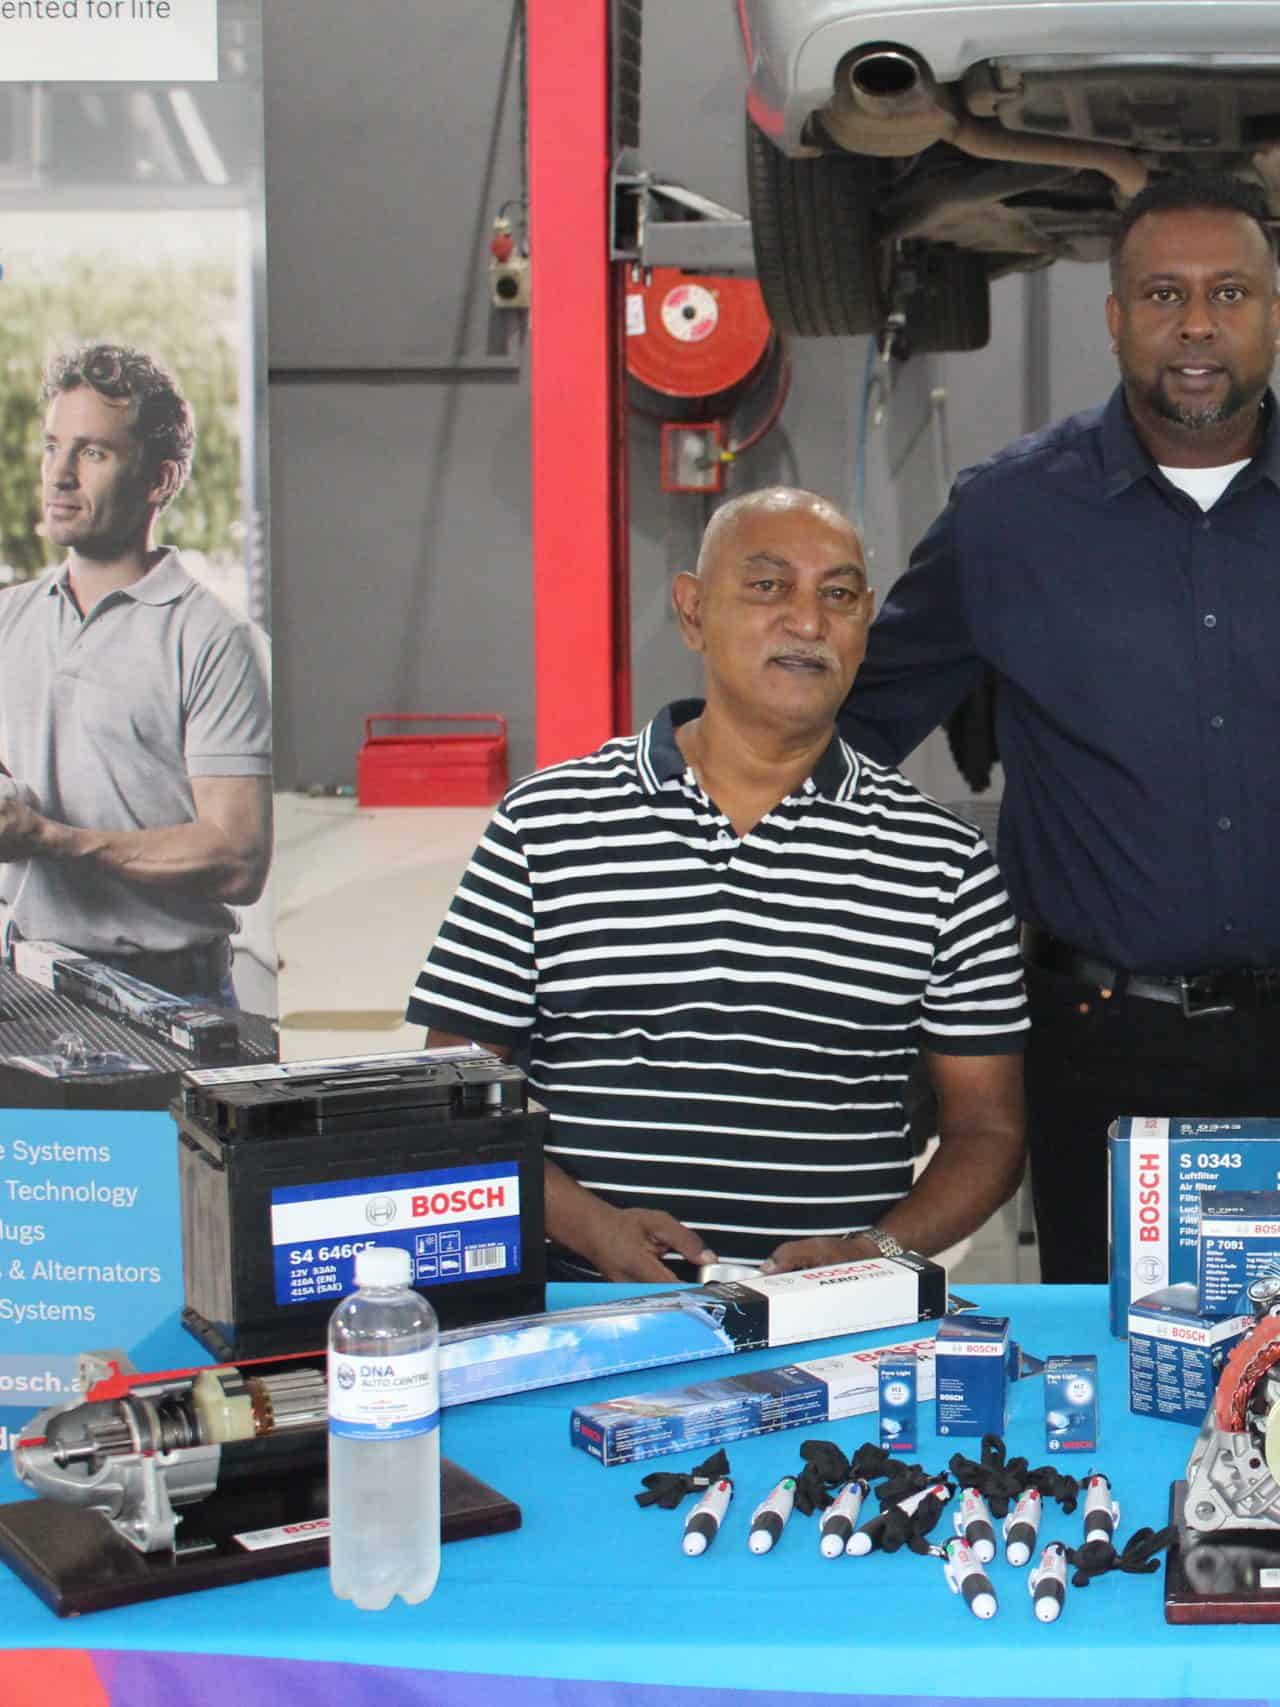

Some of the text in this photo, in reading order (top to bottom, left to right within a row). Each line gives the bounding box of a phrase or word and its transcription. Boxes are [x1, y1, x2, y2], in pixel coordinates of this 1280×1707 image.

[2, 0, 171, 19] ented for life
[13, 1140, 111, 1166] Systems
[1180, 1153, 1243, 1168] S 0343
[5, 1180, 138, 1208] Technology
[411, 1186, 505, 1218] BOSCH
[1139, 1153, 1161, 1243] BOSCH
[1206, 1240, 1215, 1249] P
[289, 1249, 314, 1265] S4
[9, 1261, 25, 1281] &
[32, 1260, 161, 1284] Alternators
[801, 1262, 883, 1281] BOSCH
[0, 1299, 96, 1323] Systems
[1171, 1327, 1206, 1343] BOSCH
[967, 1344, 998, 1354] BOSCH
[360, 1365, 395, 1378] DNA
